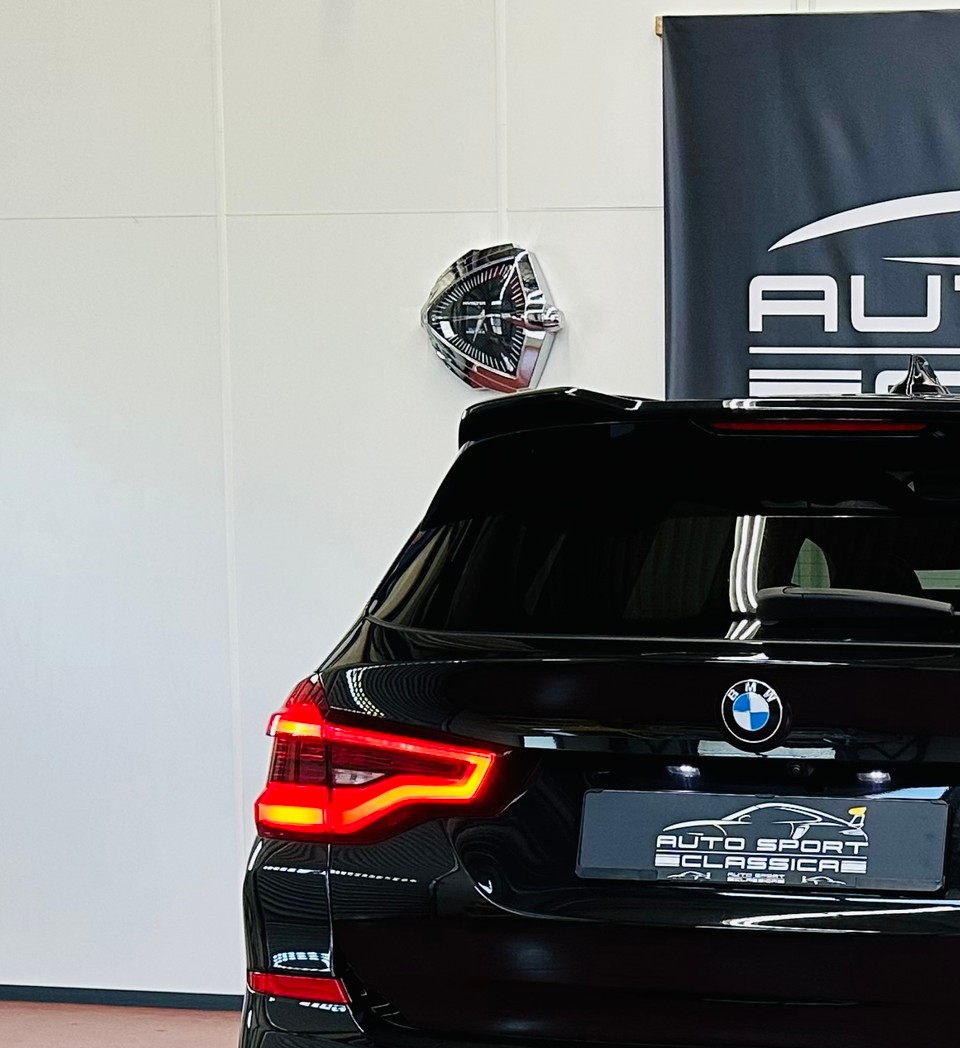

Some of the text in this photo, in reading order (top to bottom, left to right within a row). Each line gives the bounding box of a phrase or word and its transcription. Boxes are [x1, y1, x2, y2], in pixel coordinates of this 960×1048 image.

[727, 681, 777, 703] BMW
[656, 835, 869, 854] AUTO SPORT
[681, 854, 842, 873] CLASSICA
